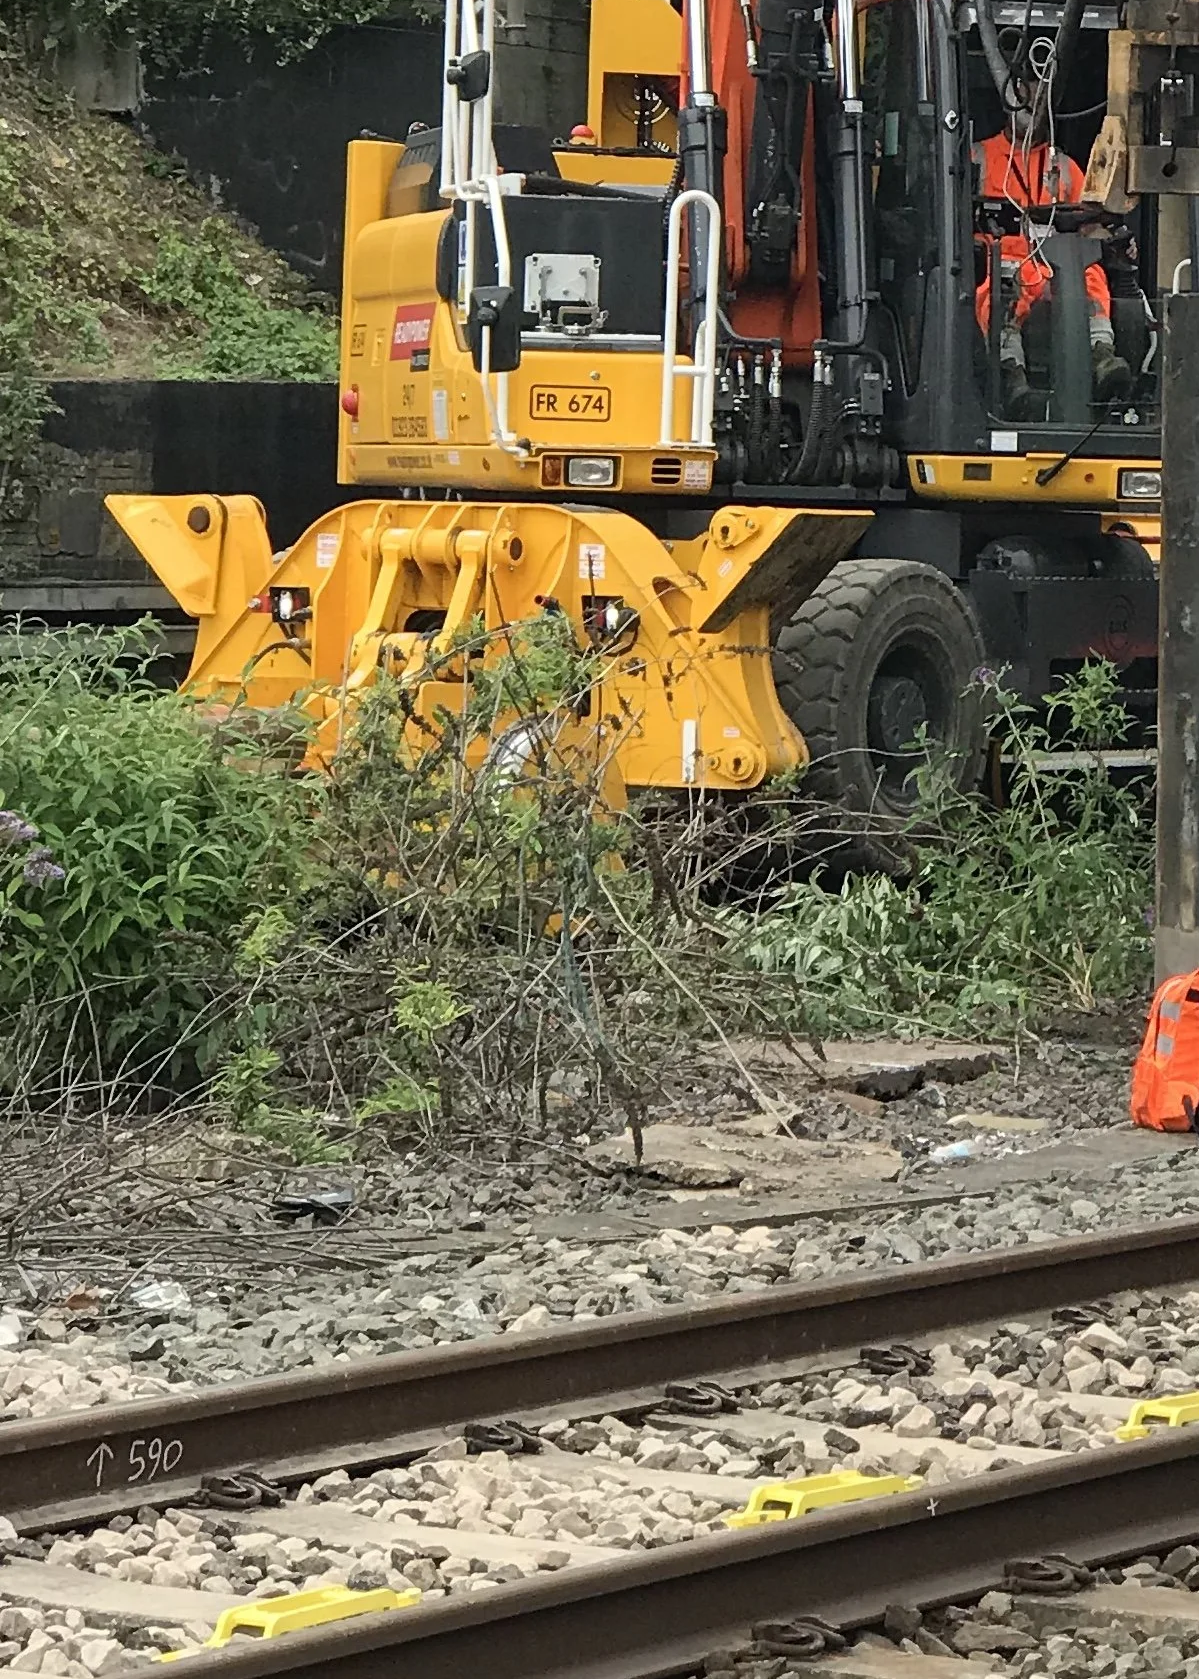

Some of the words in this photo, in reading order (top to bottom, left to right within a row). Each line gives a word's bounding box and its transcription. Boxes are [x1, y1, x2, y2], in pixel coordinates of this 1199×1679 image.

[536, 392, 558, 413] FR
[568, 393, 605, 414] 674
[127, 1437, 184, 1483] 590
